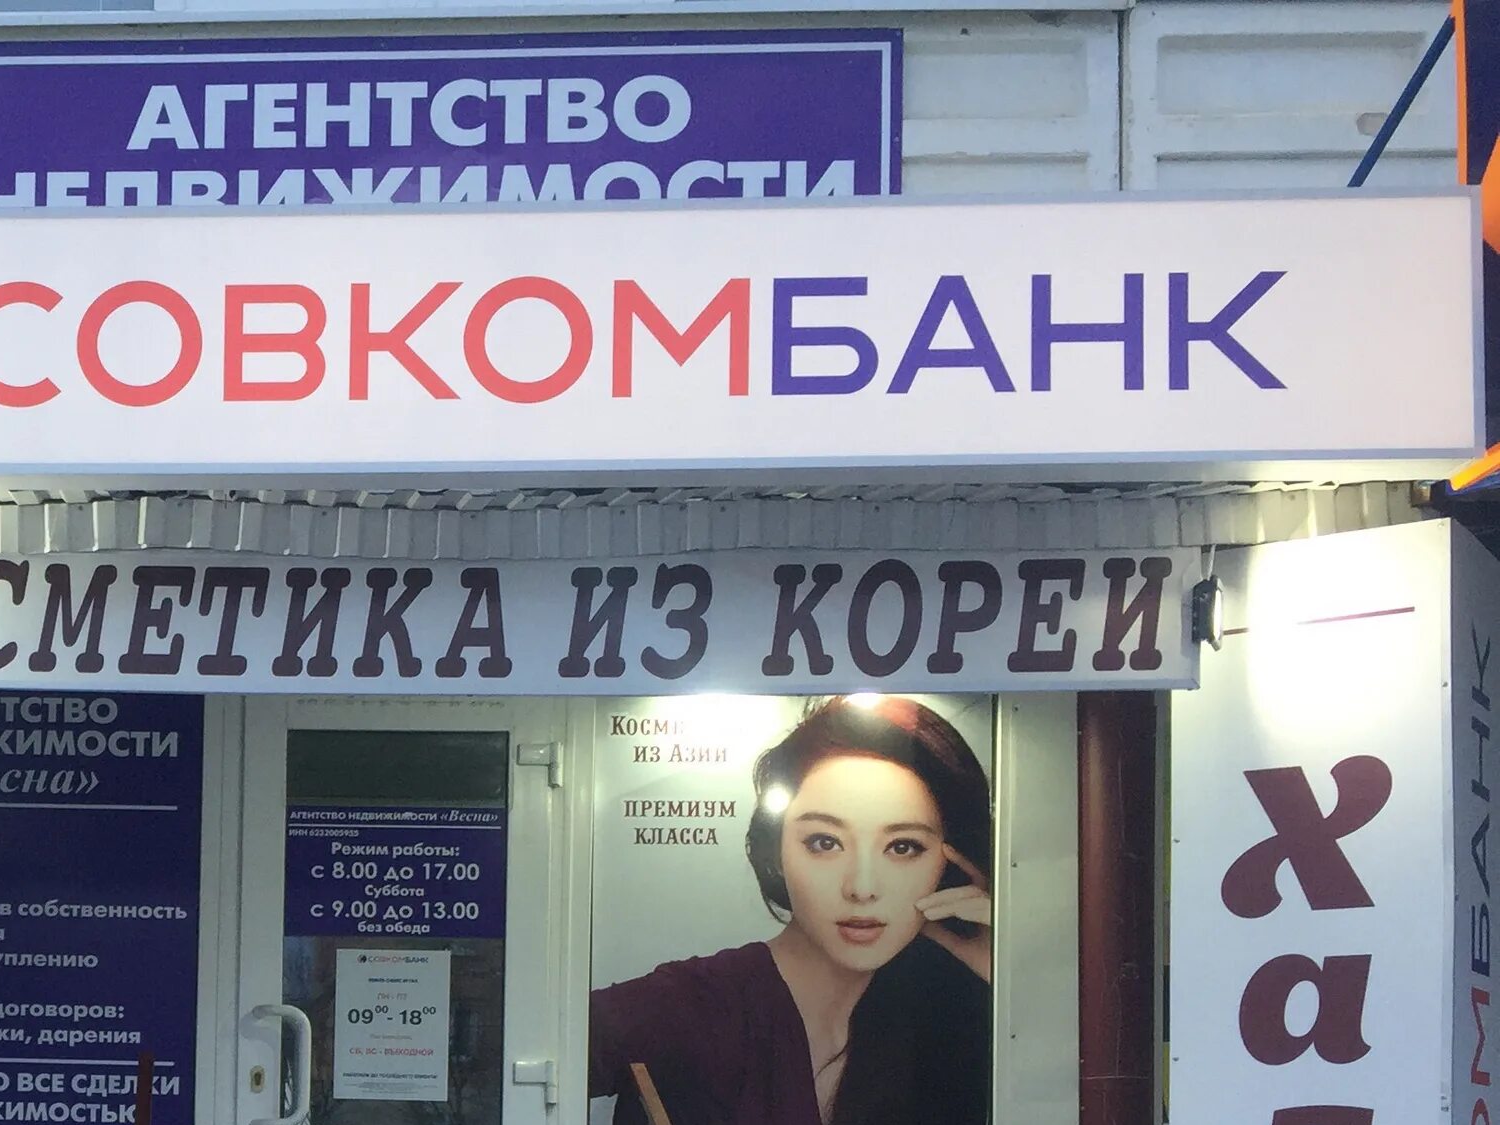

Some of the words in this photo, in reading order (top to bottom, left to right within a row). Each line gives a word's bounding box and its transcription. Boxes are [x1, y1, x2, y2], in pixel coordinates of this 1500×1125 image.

[127, 75, 692, 150] АГЕНТСТВО
[557, 561, 714, 680] ИЗ
[761, 556, 1173, 678] КОРЕИ
[290, 811, 346, 821] АГЕНТСТВО
[349, 811, 437, 822] НЕДВИЖИМОСТИ
[440, 809, 498, 823] «Весна»
[623, 800, 737, 818] ПРЕМИУМ
[634, 827, 719, 845] КЛАССА
[331, 841, 388, 856] Режим
[392, 842, 460, 859] работы:
[332, 861, 378, 880] 8.00
[383, 868, 414, 883] до
[422, 863, 480, 881] 17.00
[364, 884, 425, 899] Суббота
[0, 904, 13, 917] в
[18, 899, 188, 920] собственность
[332, 900, 377, 919] 9.00
[383, 907, 414, 921] до
[421, 901, 479, 920] 13.00
[357, 921, 382, 933] без
[385, 921, 431, 935] обеда
[37, 1028, 141, 1047] дарения
[17, 1071, 64, 1093] ВСЕ
